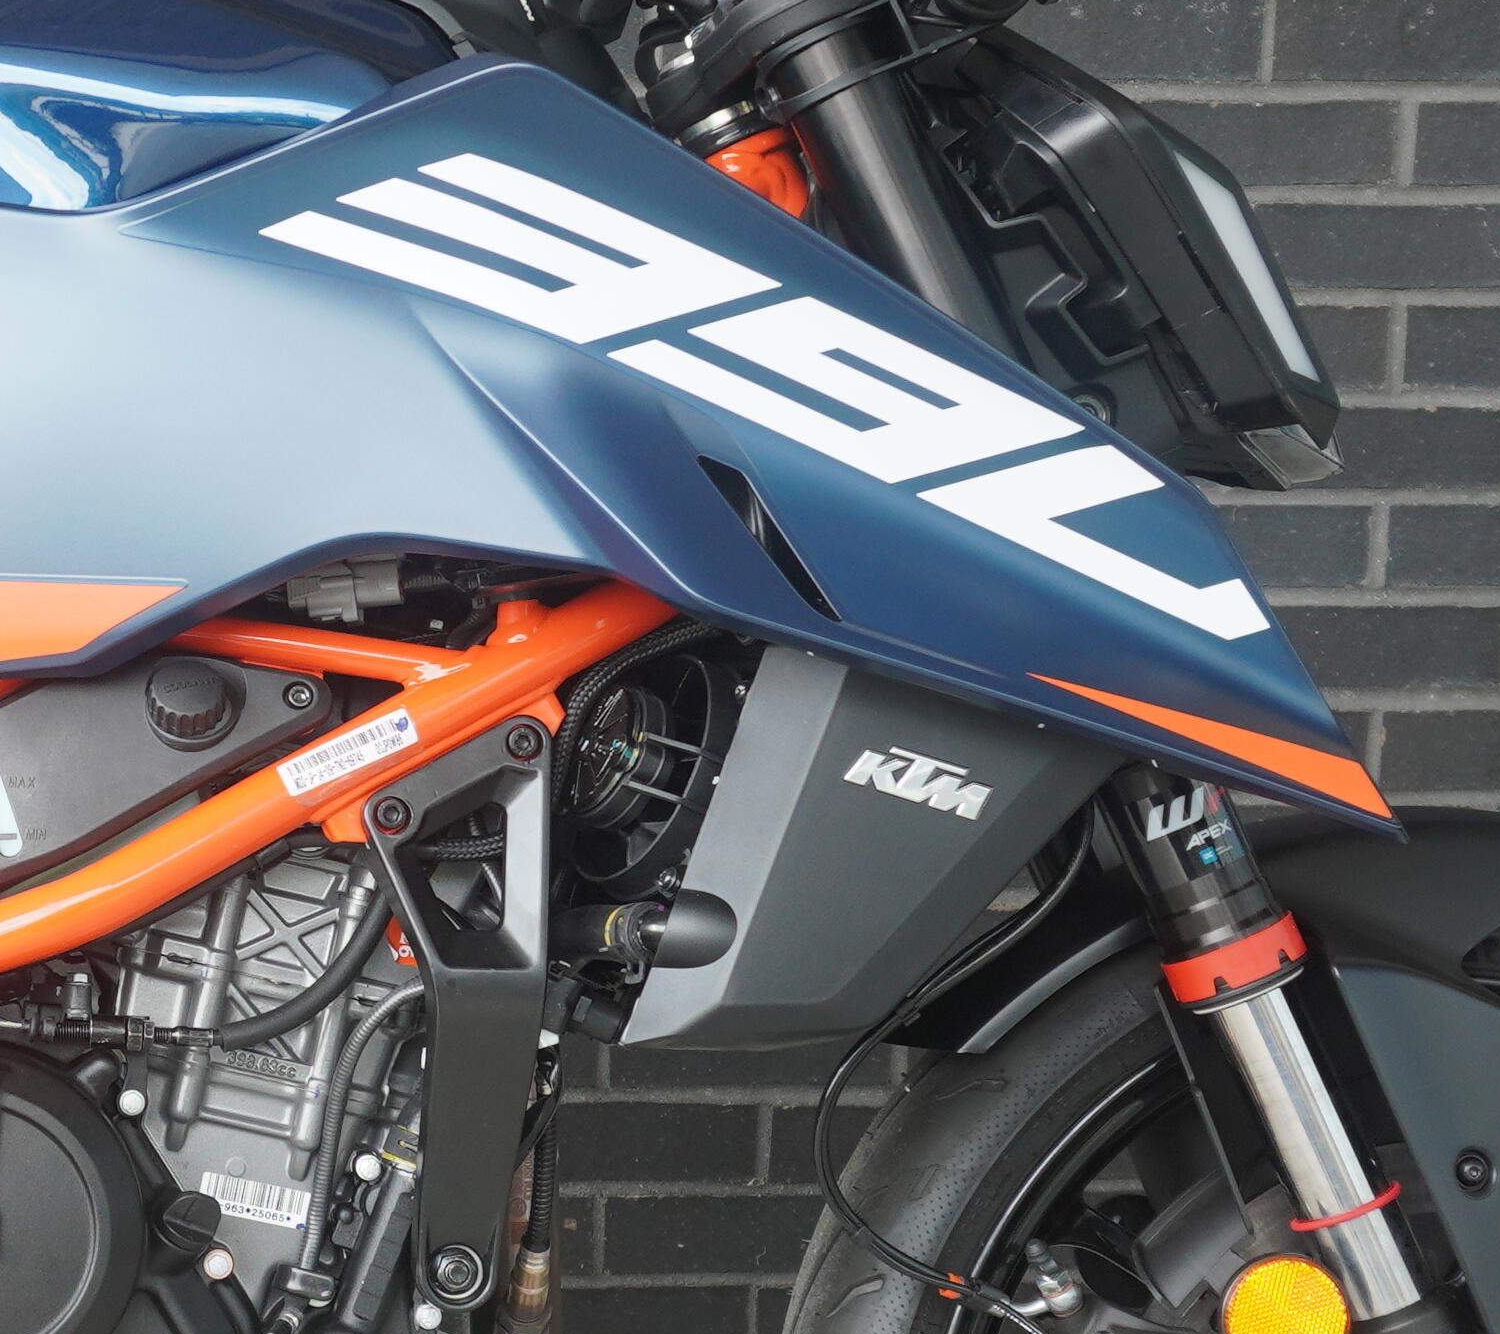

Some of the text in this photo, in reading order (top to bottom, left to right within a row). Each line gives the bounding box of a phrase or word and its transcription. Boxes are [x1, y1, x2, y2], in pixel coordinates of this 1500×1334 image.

[8, 776, 37, 789] MAX
[842, 745, 995, 822] KTM
[1185, 818, 1233, 852] APEX
